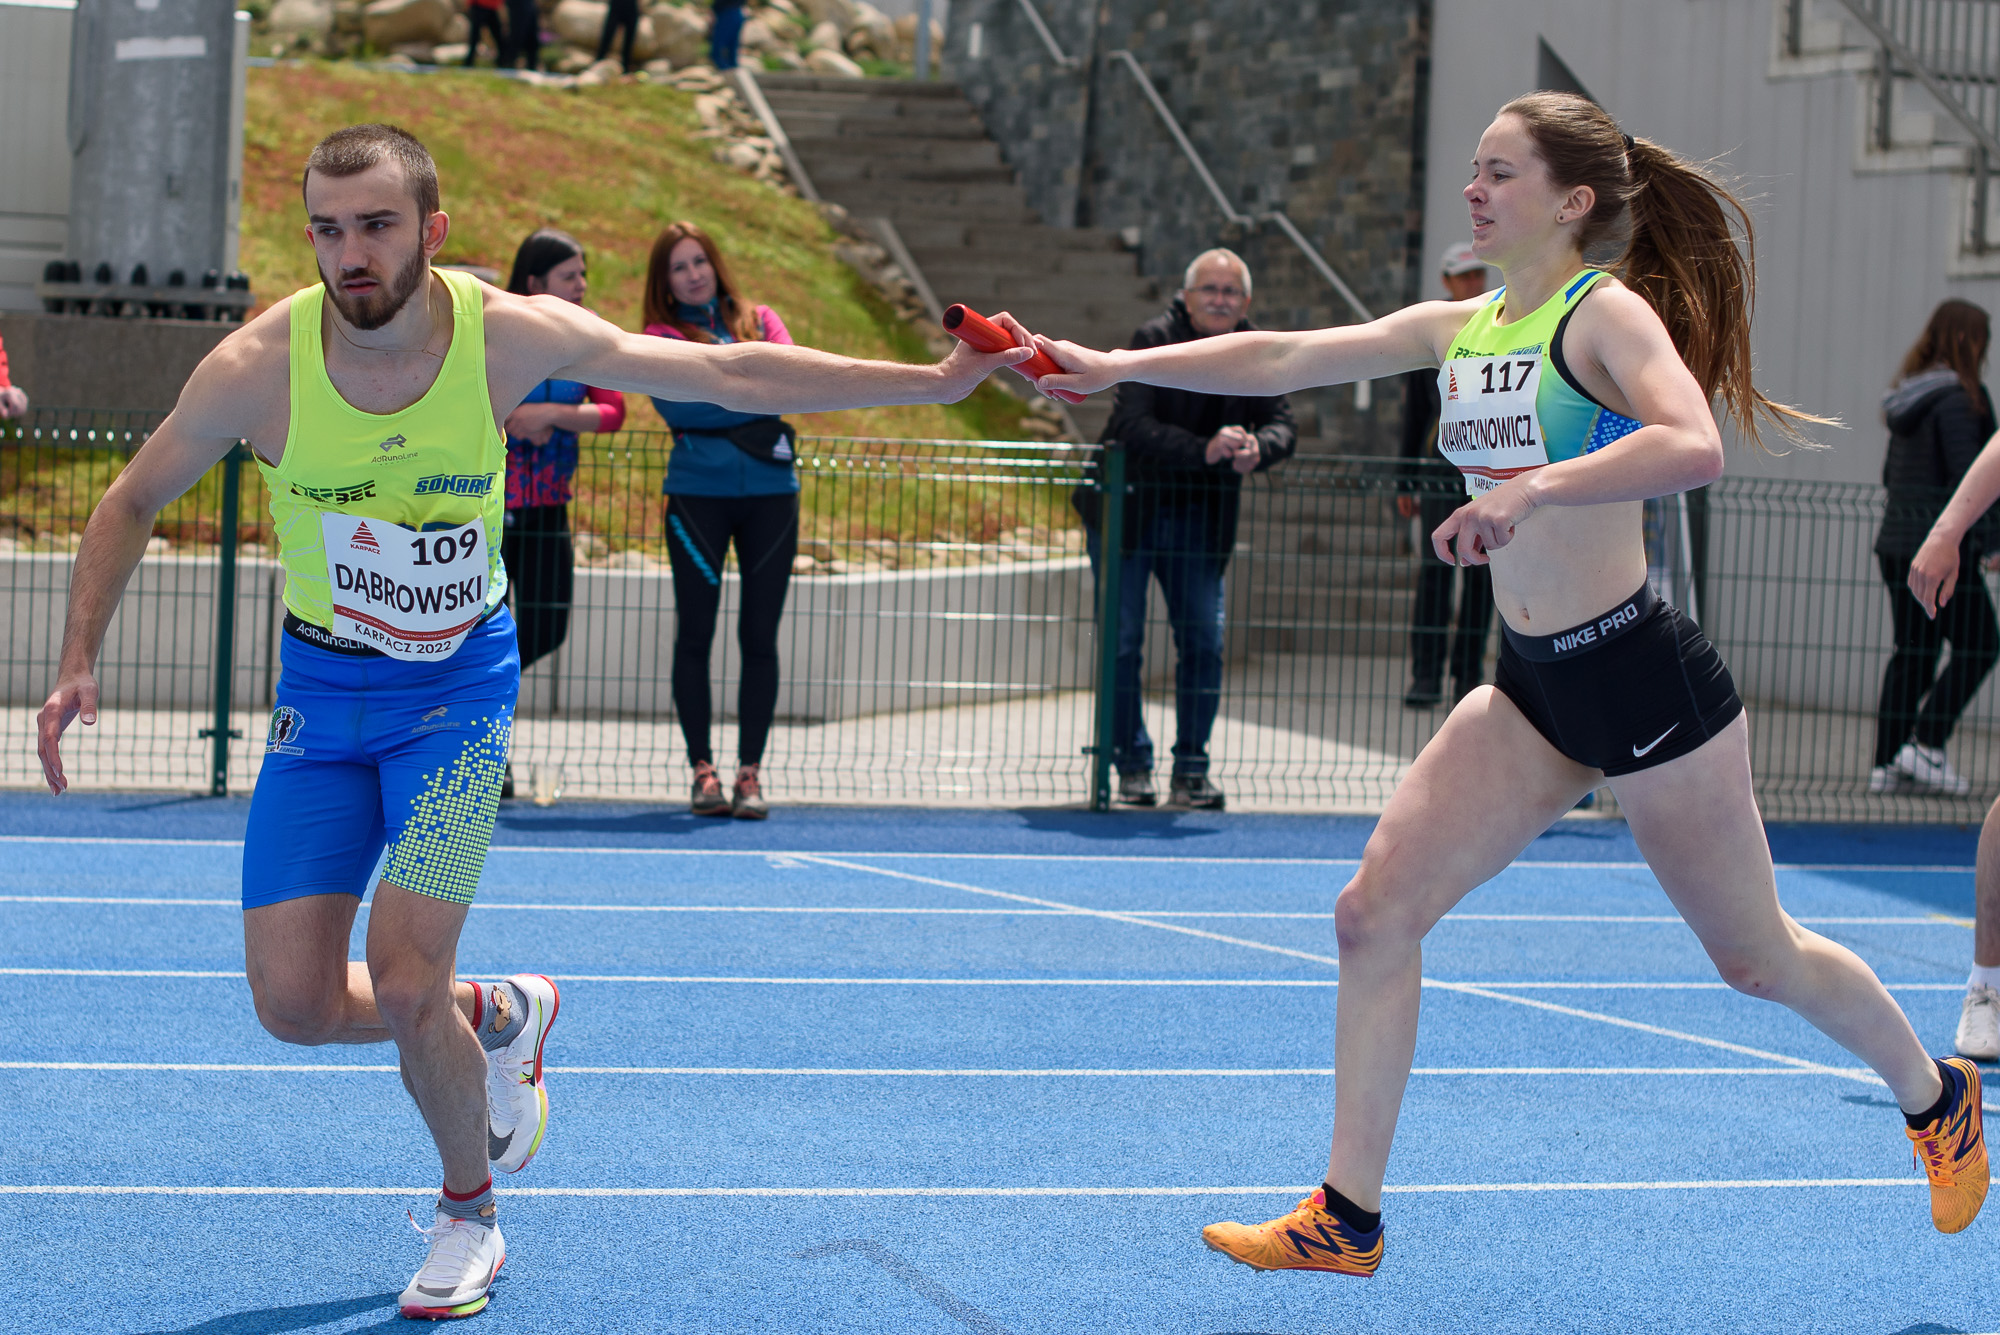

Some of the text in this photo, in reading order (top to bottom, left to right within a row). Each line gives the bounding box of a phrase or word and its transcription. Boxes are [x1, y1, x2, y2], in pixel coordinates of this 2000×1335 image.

[1481, 360, 1535, 394] 117
[1441, 415, 1536, 453] WAWRZYNOWICZ
[371, 451, 419, 464] AdRunaLine
[414, 475, 494, 498] SONARL
[350, 543, 381, 555] KARPACZ
[410, 527, 478, 567] 109
[334, 563, 483, 616] DĄBROWSKI
[296, 623, 372, 649] AdRunaLin
[354, 622, 452, 655] KARPACZ 2022
[1553, 602, 1640, 654] NIKE PRO
[282, 706, 293, 714] KS
